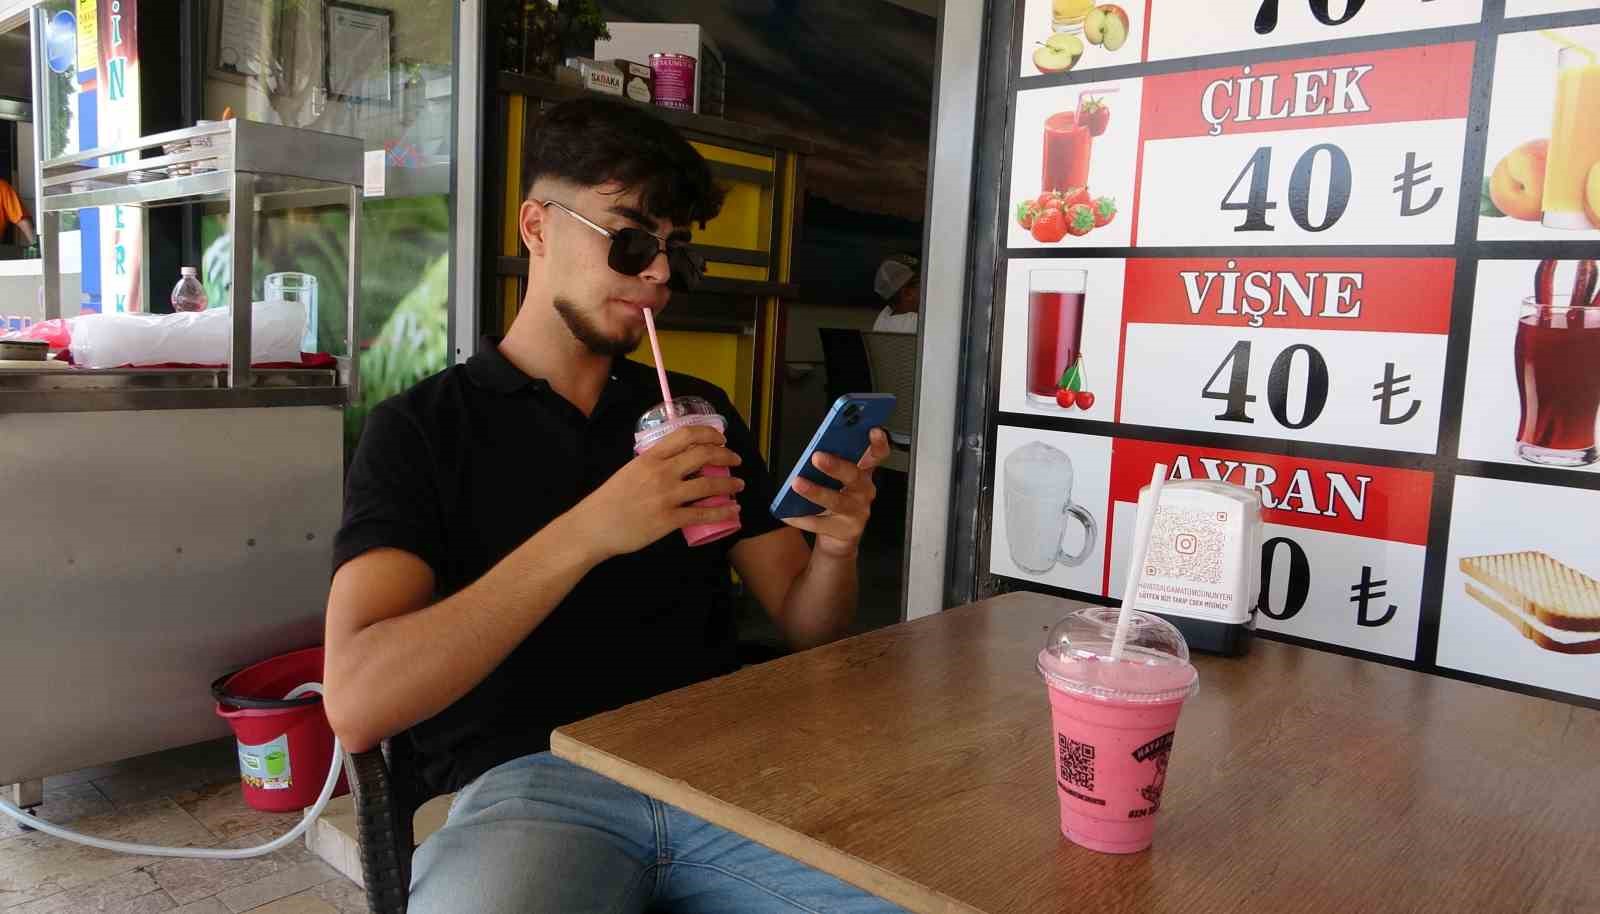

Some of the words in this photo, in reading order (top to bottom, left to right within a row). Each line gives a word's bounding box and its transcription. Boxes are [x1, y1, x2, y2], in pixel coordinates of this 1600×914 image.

[1201, 65, 1373, 136] ÇİLEK
[1220, 143, 1352, 232] 40
[1392, 151, 1444, 217] ₺
[1179, 259, 1363, 327] VİŞNE
[1201, 340, 1329, 430] 40
[1372, 362, 1422, 425] ₺
[1167, 454, 1373, 521] AYRAN
[1257, 536, 1311, 620] 0
